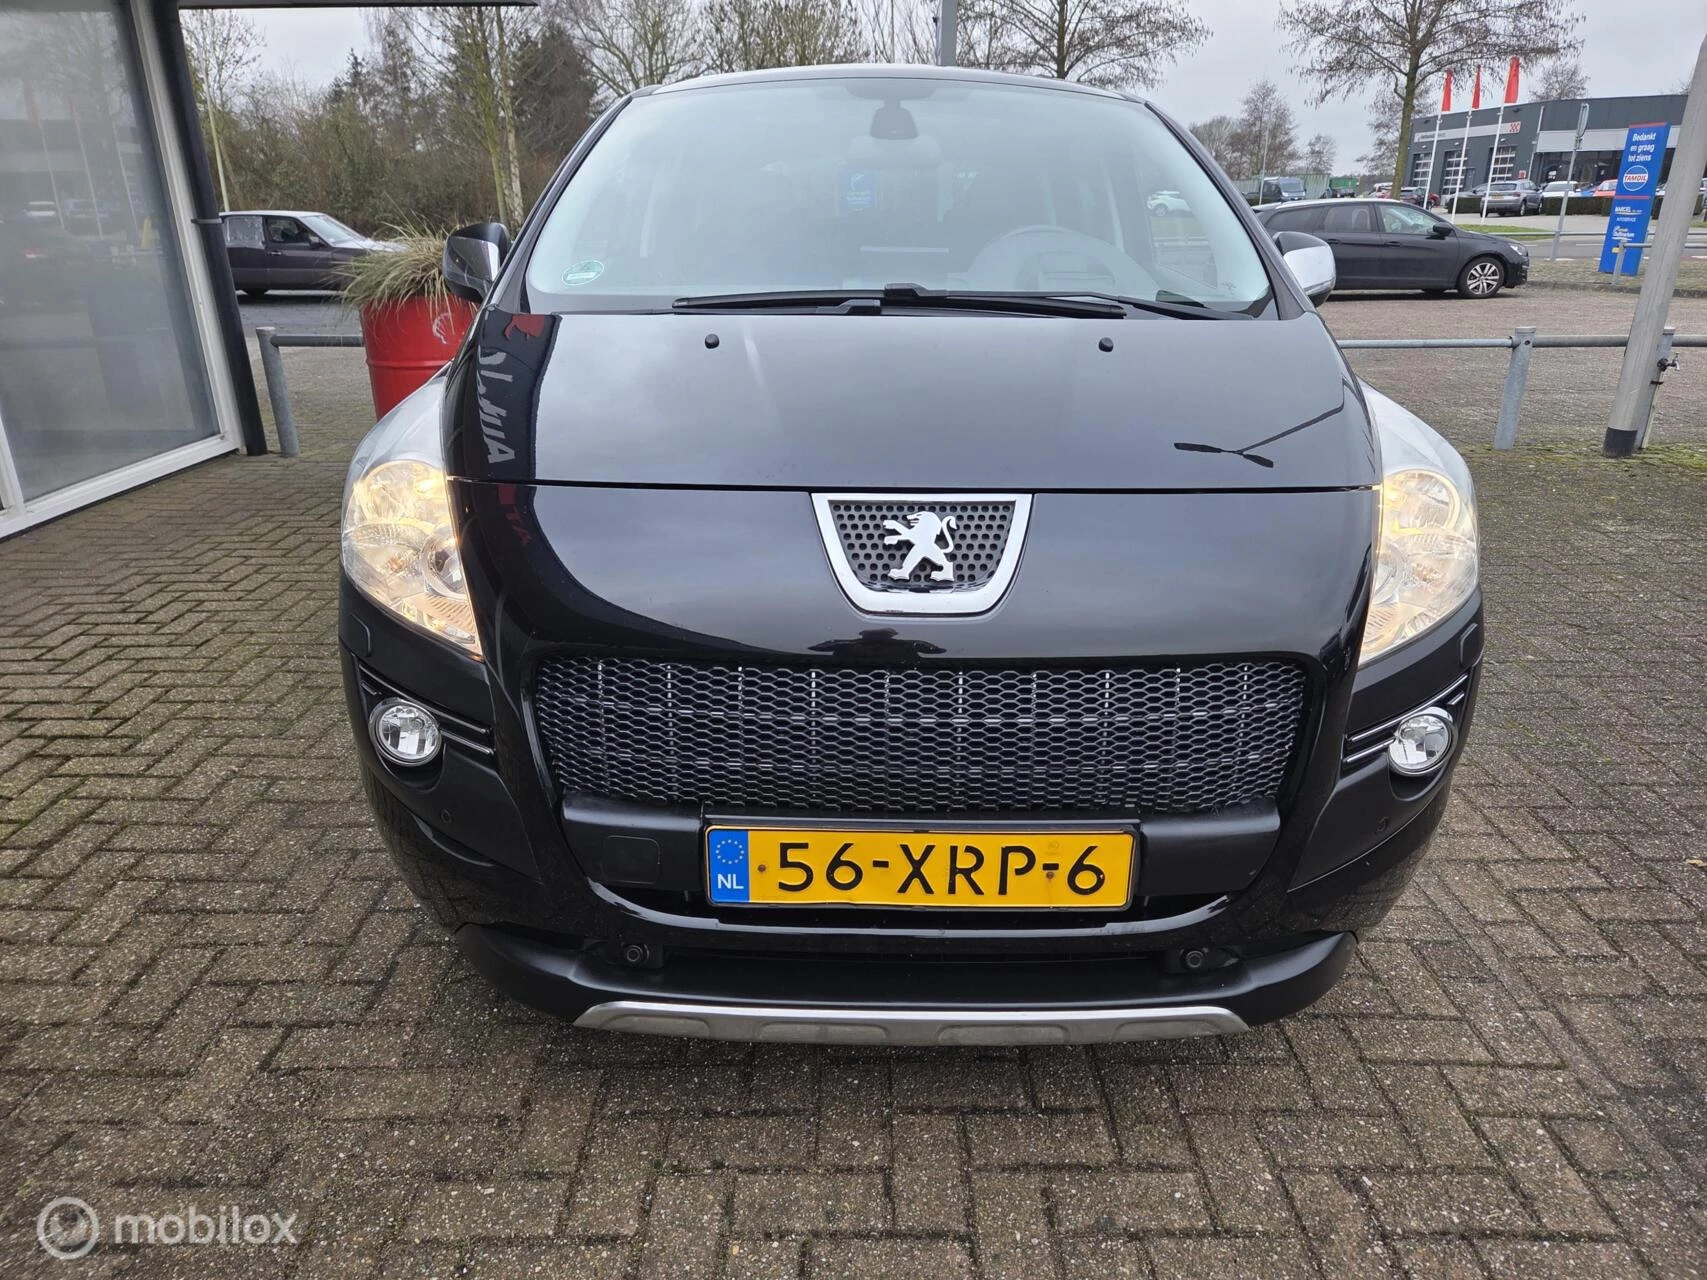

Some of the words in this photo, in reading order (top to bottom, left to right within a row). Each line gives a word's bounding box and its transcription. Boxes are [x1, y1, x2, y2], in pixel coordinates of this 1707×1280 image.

[1632, 132, 1656, 141] Bedankt
[1638, 144, 1655, 153] graag
[1636, 154, 1652, 162] ziens
[778, 841, 1105, 896] 56-XRP-6
[717, 873, 744, 890] NL
